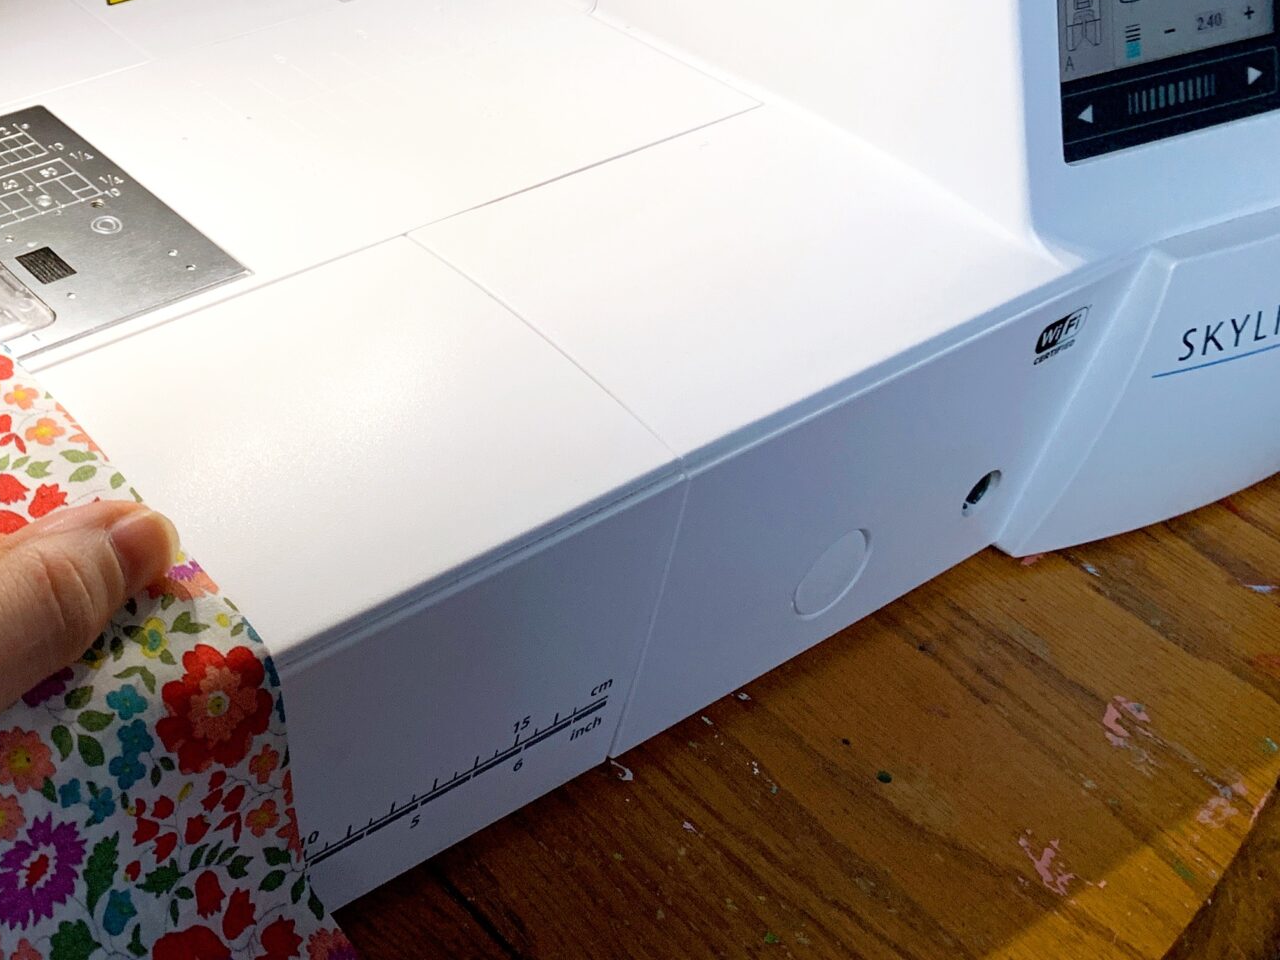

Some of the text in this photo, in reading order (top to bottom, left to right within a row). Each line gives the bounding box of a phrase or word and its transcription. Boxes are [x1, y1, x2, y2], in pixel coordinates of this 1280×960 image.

[1197, 12, 1222, 31] 2.40
[590, 678, 613, 697] cm
[512, 716, 531, 734] 15
[569, 715, 602, 742] inch
[410, 758, 523, 829] 5 6
